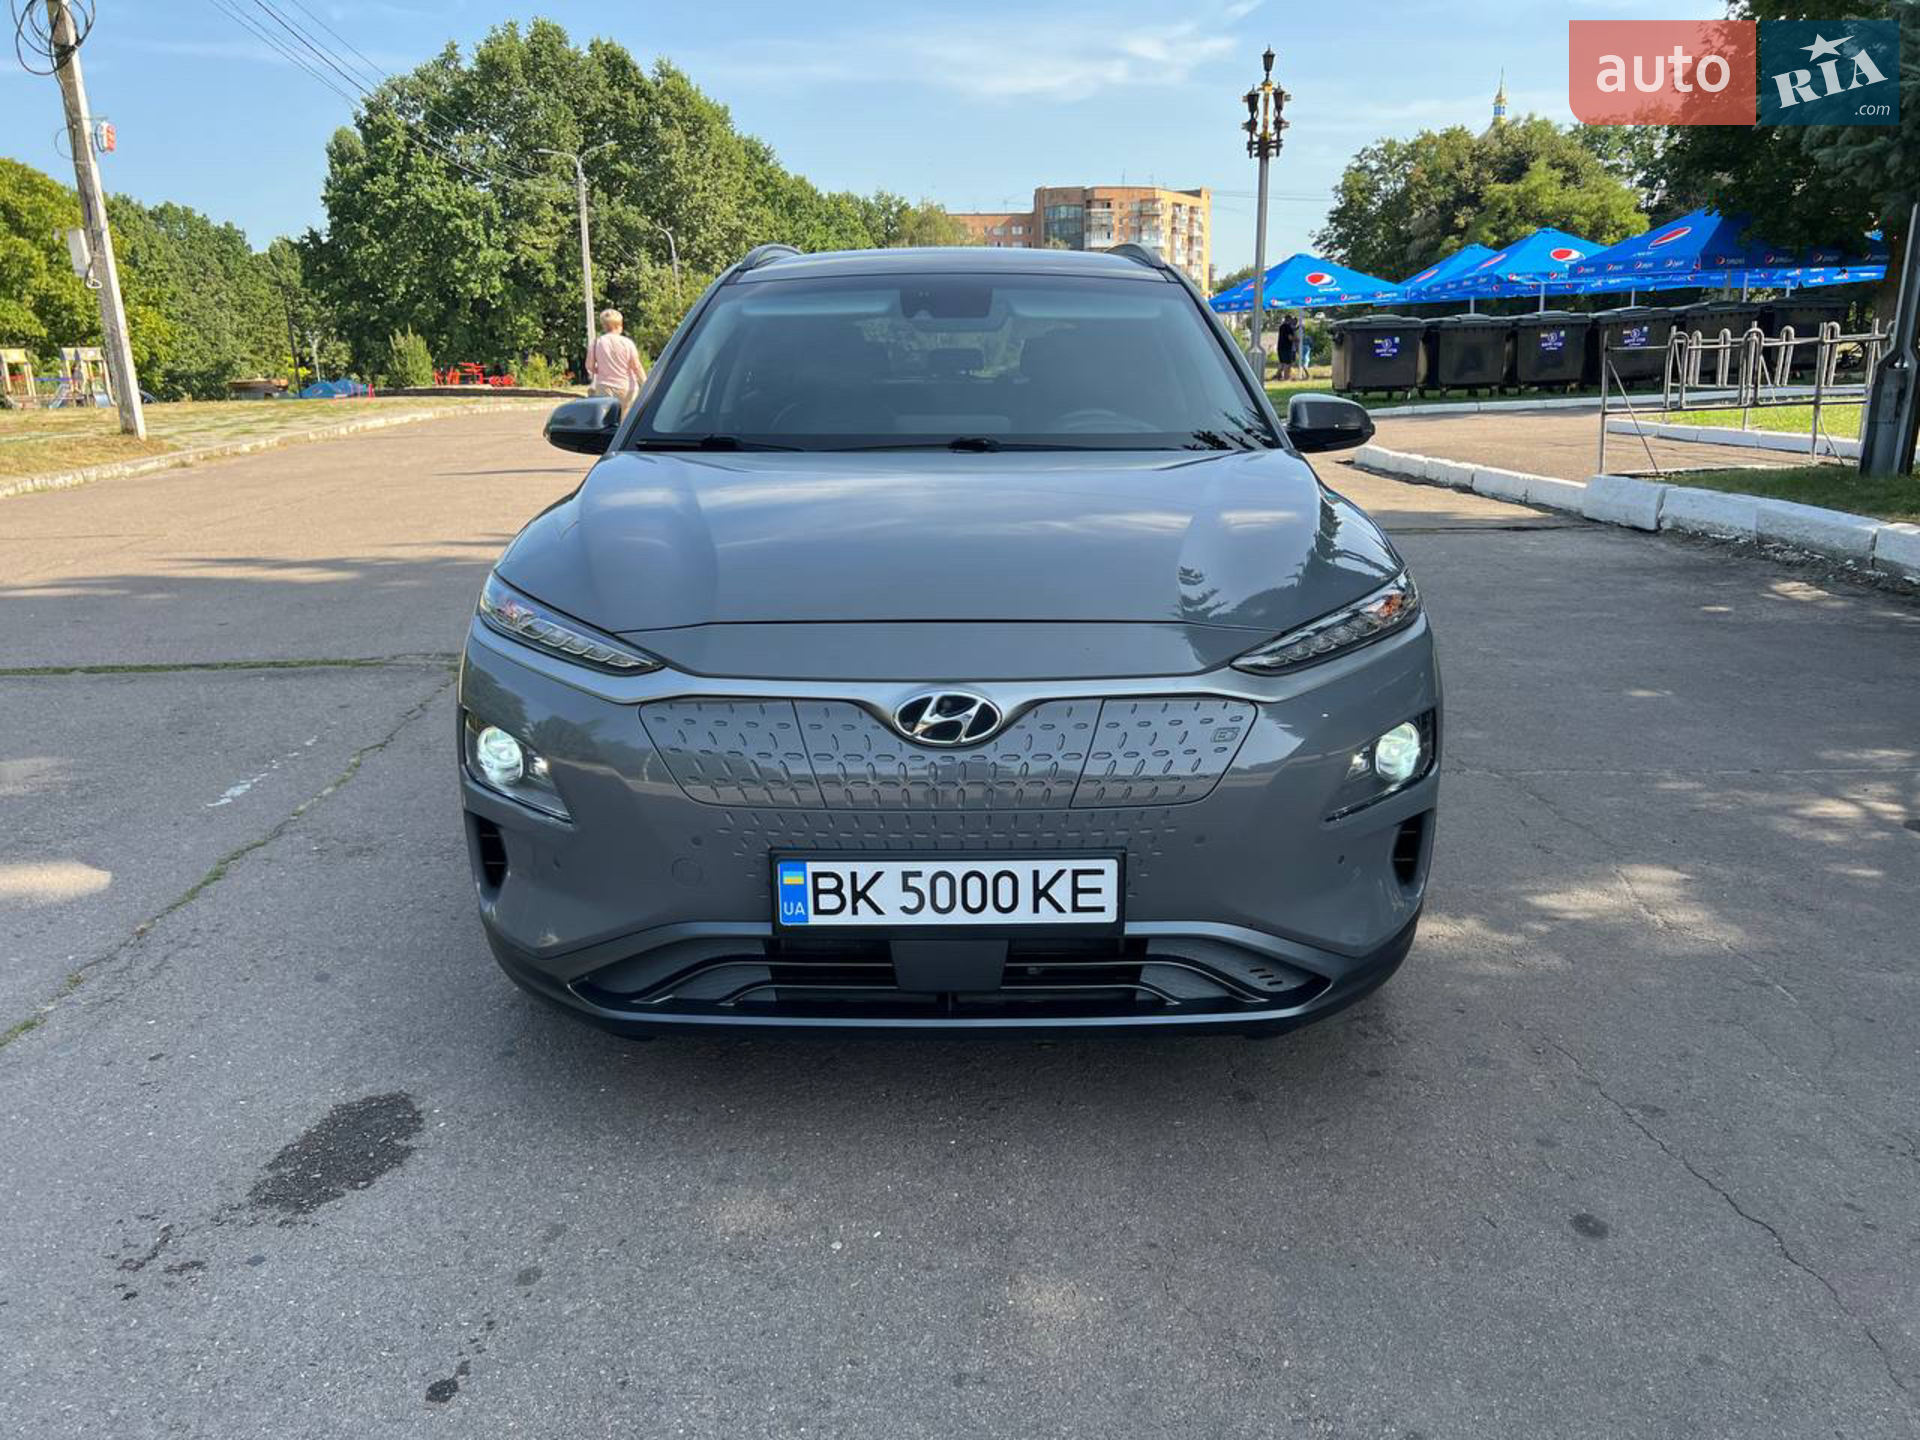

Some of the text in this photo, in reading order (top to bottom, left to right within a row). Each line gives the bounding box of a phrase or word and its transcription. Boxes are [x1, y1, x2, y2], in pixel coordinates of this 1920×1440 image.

[811, 869, 1106, 916] BK 5000 KE
[783, 902, 805, 915] UA
